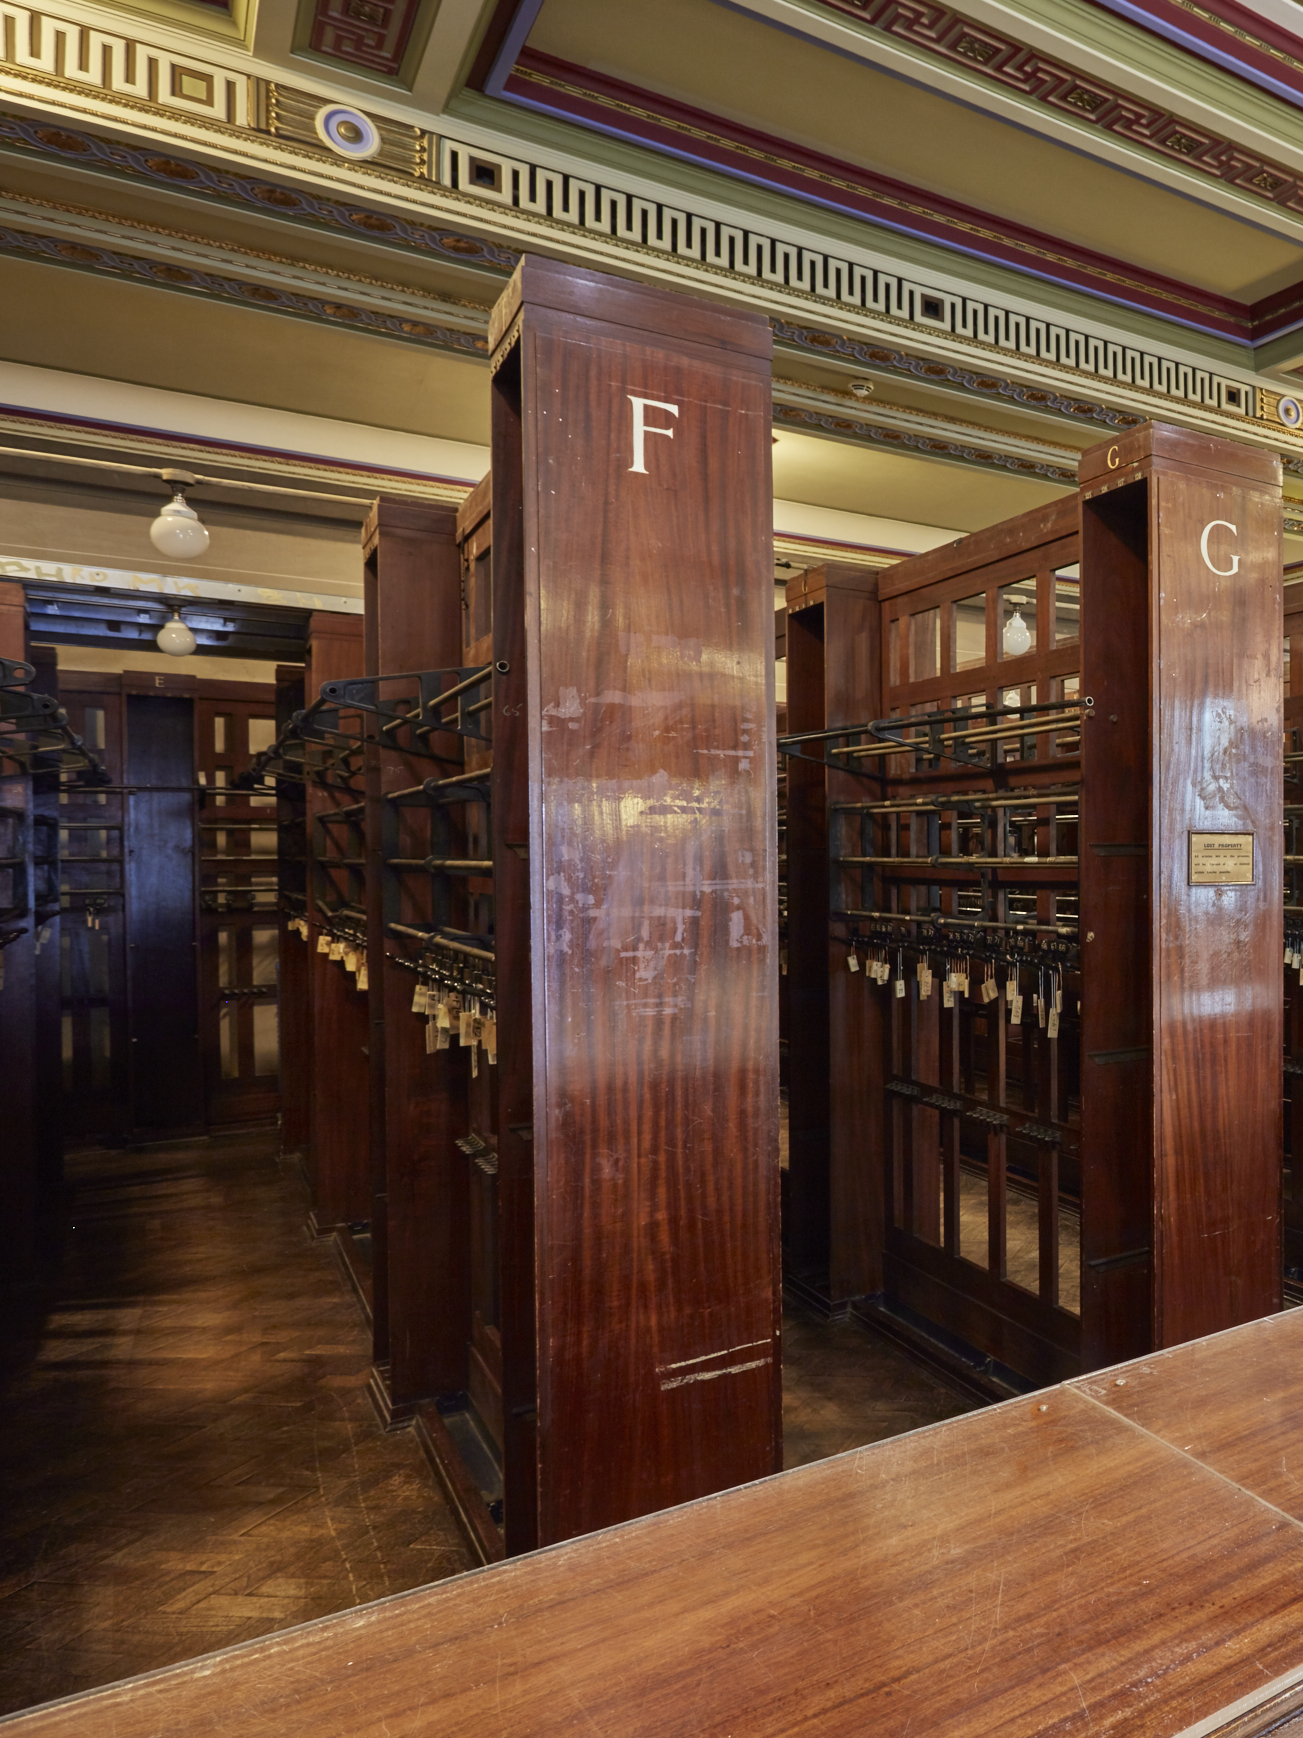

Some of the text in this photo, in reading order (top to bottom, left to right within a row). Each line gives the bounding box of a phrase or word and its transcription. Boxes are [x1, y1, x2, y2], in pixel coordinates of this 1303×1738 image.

[627, 394, 679, 475] F
[1106, 445, 1120, 469] G
[1201, 519, 1241, 577] G
[155, 675, 165, 687] E
[502, 703, 523, 717] 65
